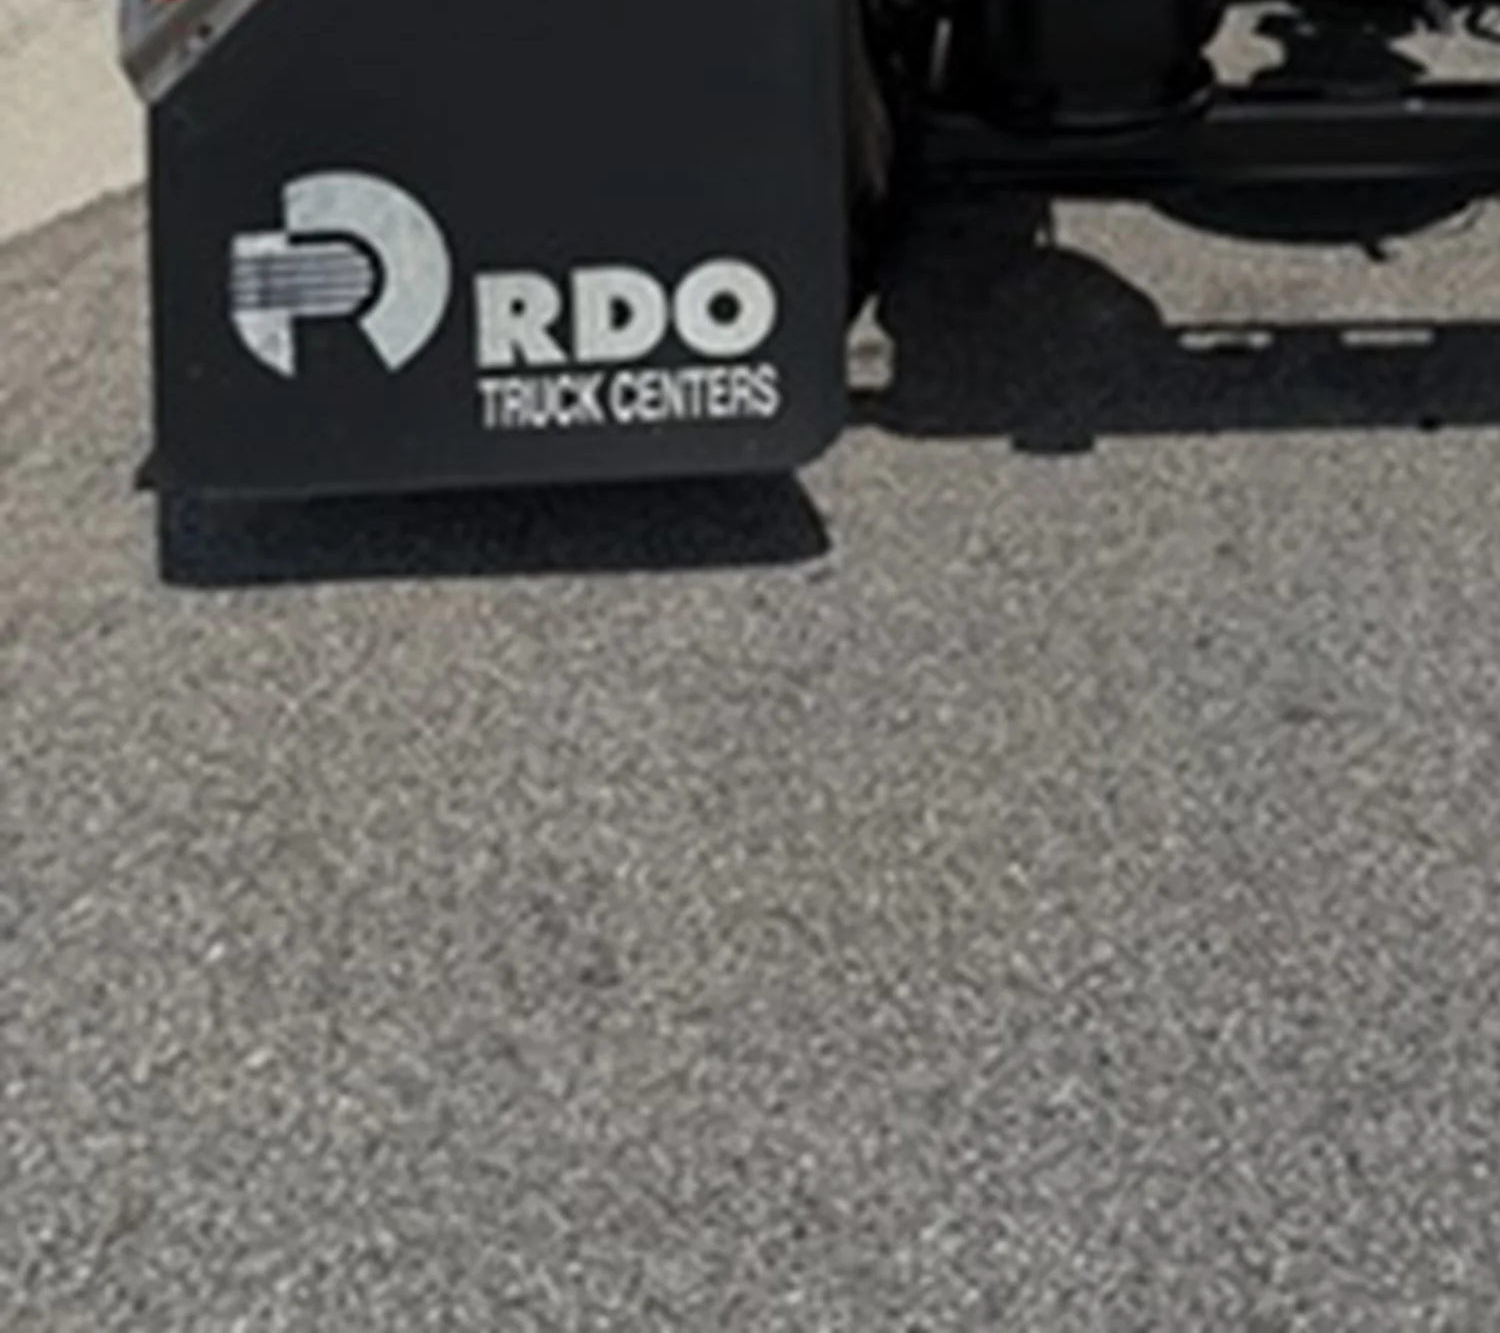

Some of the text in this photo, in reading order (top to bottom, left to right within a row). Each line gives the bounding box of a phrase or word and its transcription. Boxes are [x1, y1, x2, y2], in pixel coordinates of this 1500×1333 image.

[473, 258, 777, 369] RDO
[478, 364, 781, 429] TRUCK CENTERS
